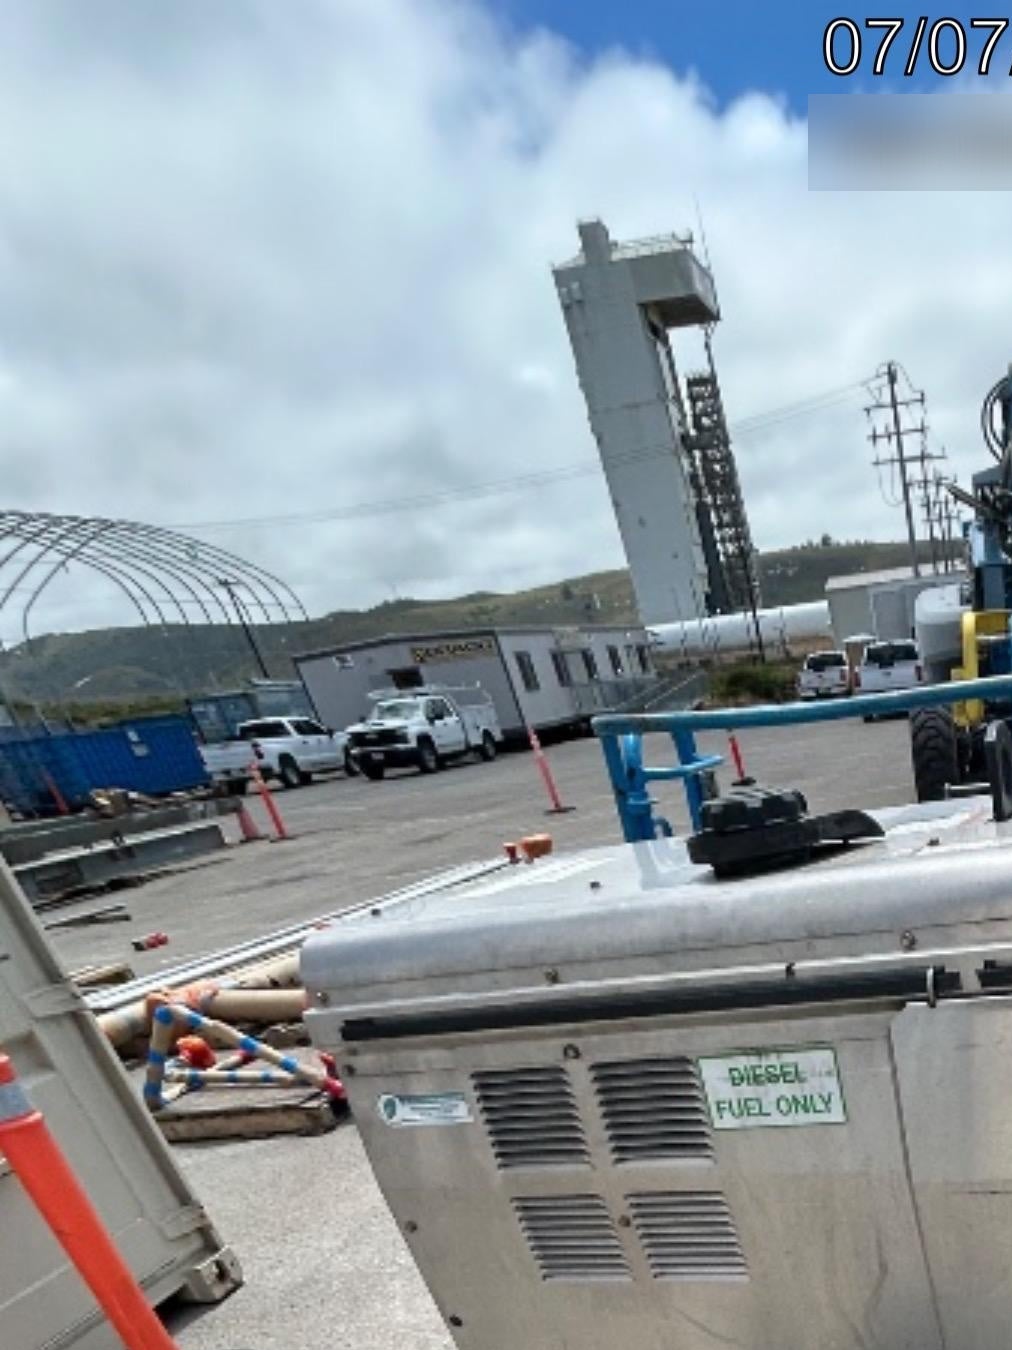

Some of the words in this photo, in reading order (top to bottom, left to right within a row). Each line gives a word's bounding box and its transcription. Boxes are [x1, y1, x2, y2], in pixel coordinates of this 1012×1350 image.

[728, 1061, 808, 1087] DIESEL
[715, 1096, 772, 1119] FUEL
[776, 1091, 833, 1116] ONLY
